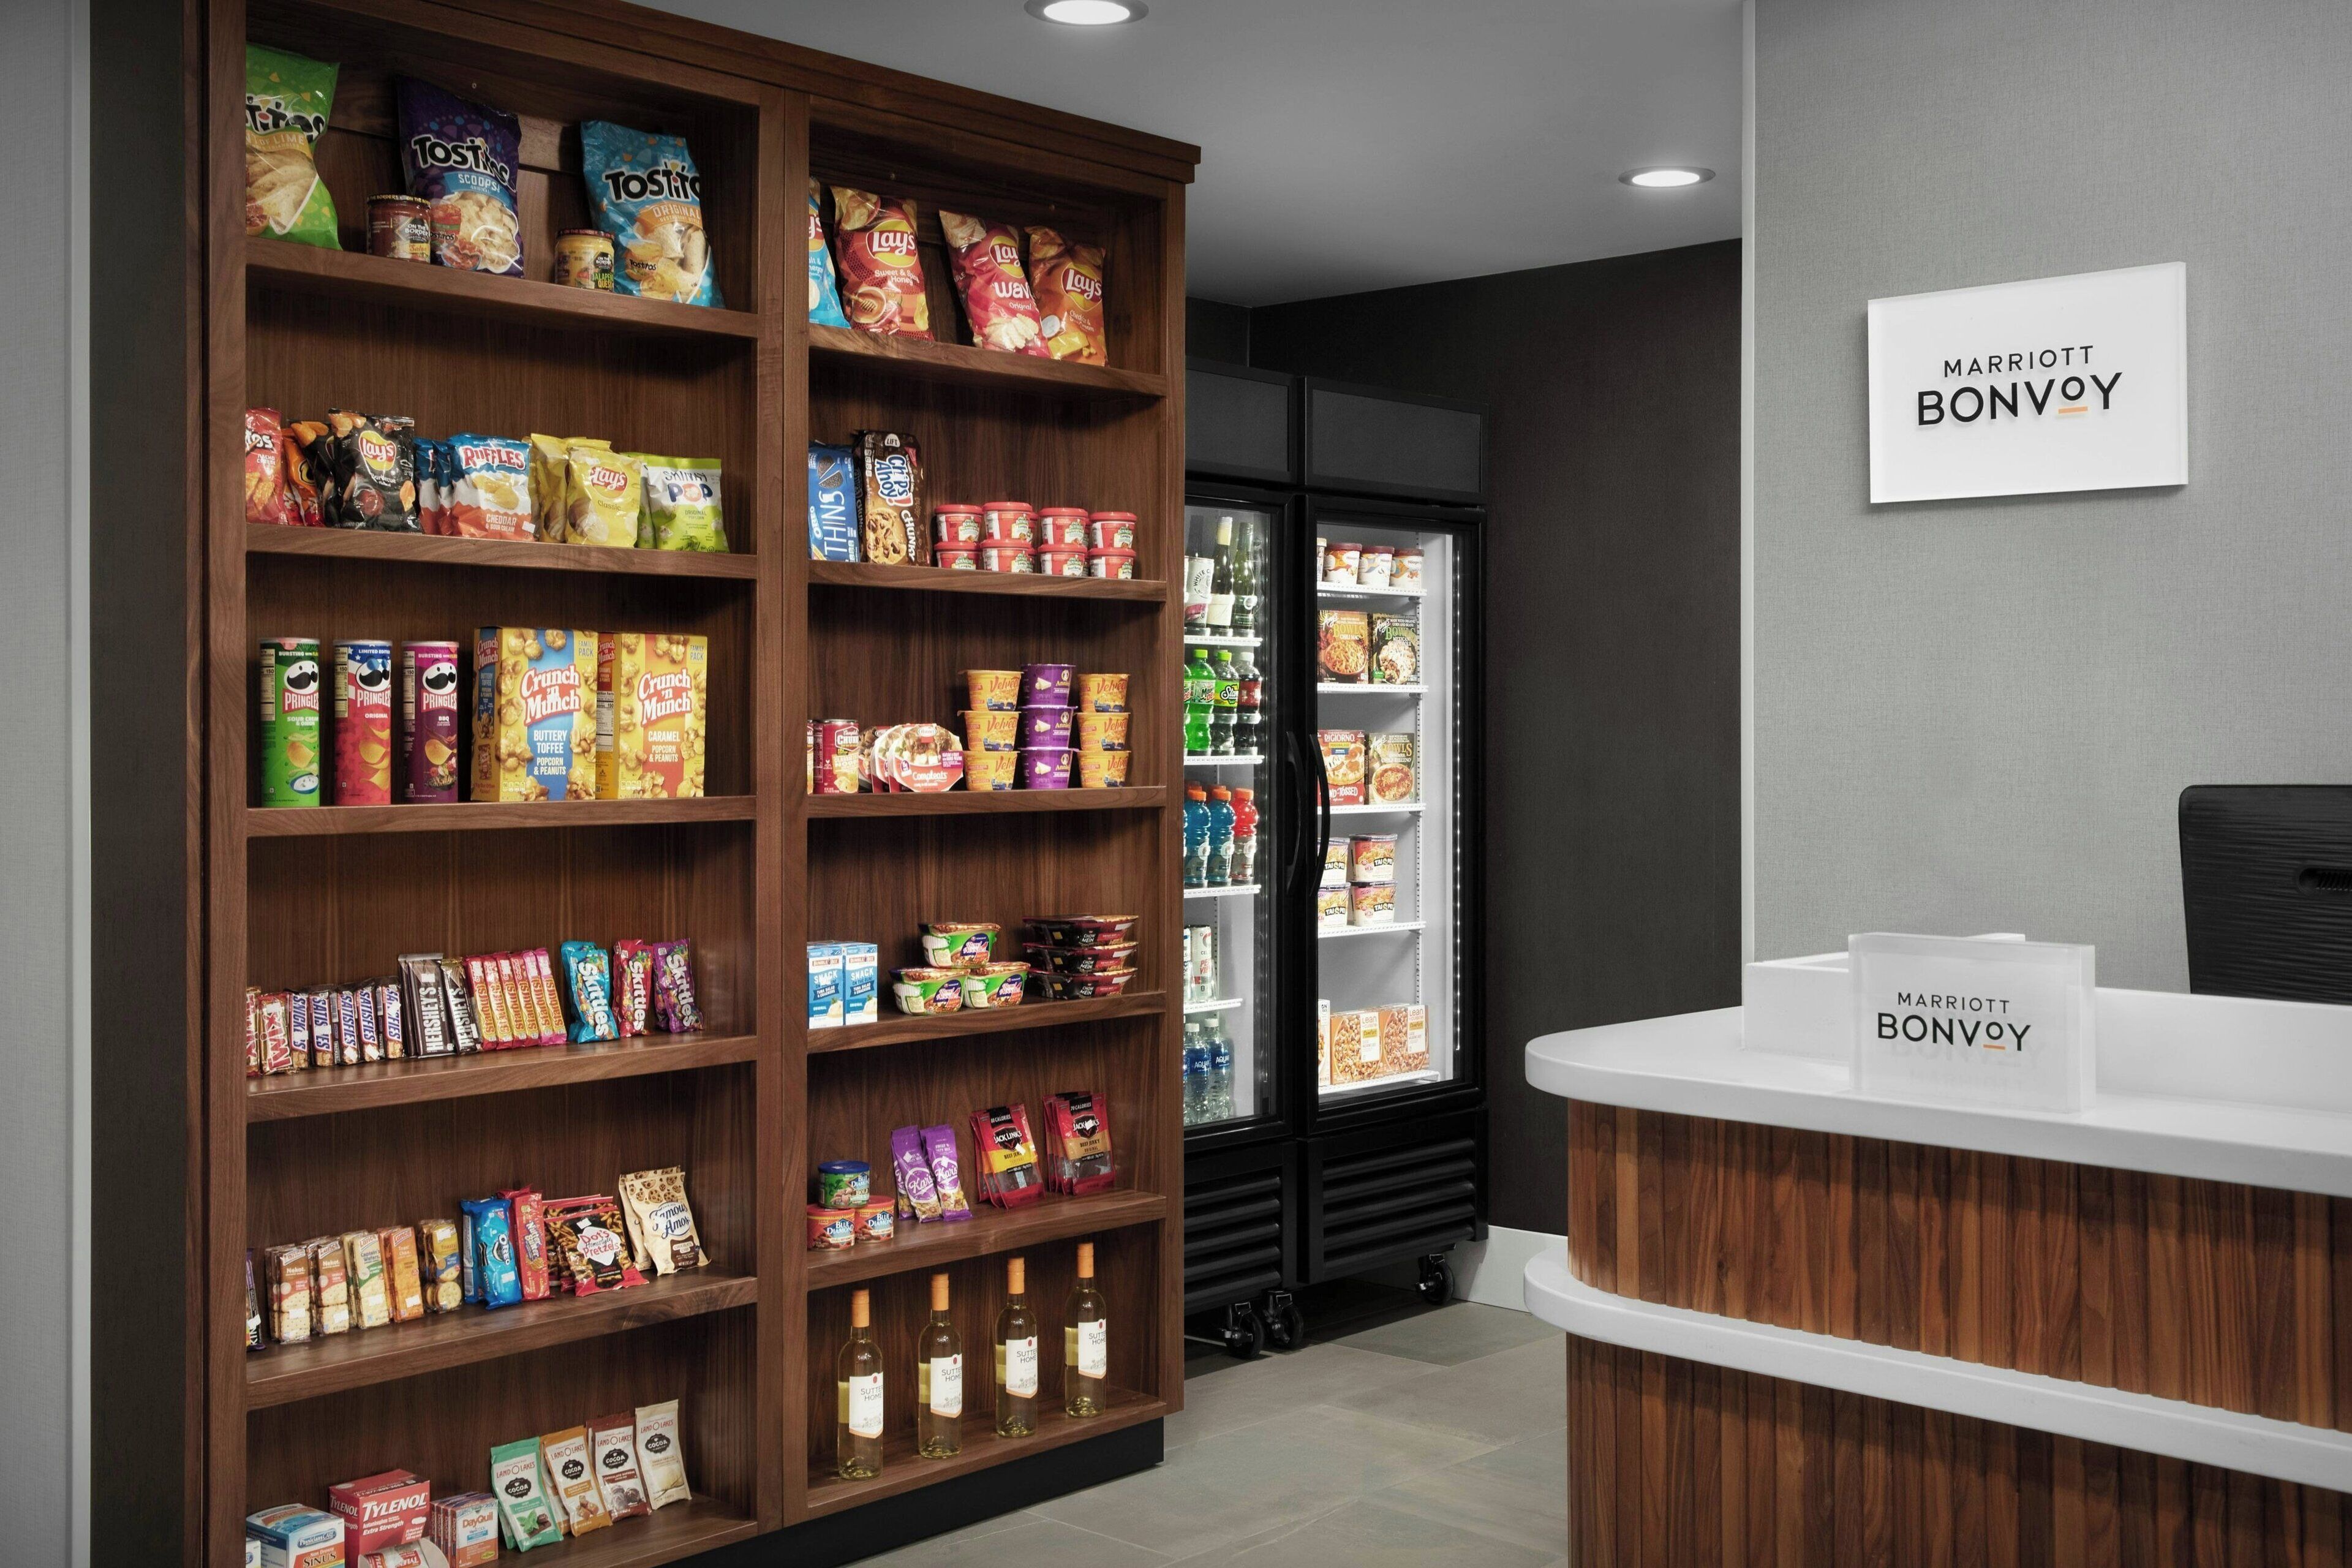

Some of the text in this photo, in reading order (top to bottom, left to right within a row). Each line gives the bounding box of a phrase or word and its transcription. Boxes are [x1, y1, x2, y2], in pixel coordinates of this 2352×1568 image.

[653, 204, 700, 219] ORIGINAL
[1944, 345, 2093, 377] MARRIOTT
[1918, 372, 2123, 426] BONVOY
[462, 447, 525, 470] RUFFLES
[668, 483, 713, 503] POP
[486, 514, 517, 526] CHEDDAR
[818, 490, 848, 556] THINS
[902, 510, 916, 562] CHUNKY
[578, 647, 594, 657] PACK
[690, 652, 704, 662] PACK
[521, 665, 580, 698] Crunch
[638, 668, 692, 698] Crunch
[526, 688, 580, 723] Munch
[643, 692, 692, 725] Munch
[533, 729, 567, 742] BUTTERY
[648, 731, 680, 742] CARAMEL
[537, 742, 564, 754] TOFFEE
[652, 745, 676, 753] POPCORN
[537, 757, 564, 766] POPCORN
[649, 754, 678, 763] & PEANUTS
[533, 766, 566, 775] & PEANUTS
[851, 967, 873, 981] SNACK
[1898, 992, 2010, 1014] MARRIOTT
[340, 993, 357, 1047] SATISFIES
[360, 989, 378, 1044] SATISFIES
[419, 987, 444, 1053] HERSHEY'S
[1362, 1015, 1377, 1024] Lean
[1409, 1008, 1423, 1017] Lean
[1877, 1012, 2031, 1052] BONVOY
[1072, 1122, 1085, 1131] JACK
[993, 1134, 1007, 1144] JACK
[662, 1215, 688, 1240] Amos
[827, 1224, 854, 1234] DIAMOND
[868, 1217, 894, 1226] DIAMOND
[581, 1229, 610, 1244] Dot's
[583, 1240, 620, 1257] Pretzels
[660, 1419, 673, 1428] LAKES
[551, 1452, 564, 1460] LAND
[571, 1444, 585, 1453] LAKES
[648, 1440, 668, 1449] COCOA
[606, 1455, 625, 1464] COCOA
[496, 1468, 511, 1479] LAND
[521, 1461, 535, 1471] LAKES
[564, 1465, 581, 1474] COCOA
[508, 1485, 529, 1494] COCOA
[330, 1495, 358, 1518] TYLENOL
[363, 1493, 428, 1522] TYLENOL
[363, 1520, 404, 1536] Extra Strength
[462, 1512, 494, 1529] DayQuil
[303, 1551, 337, 1567] SINUS
